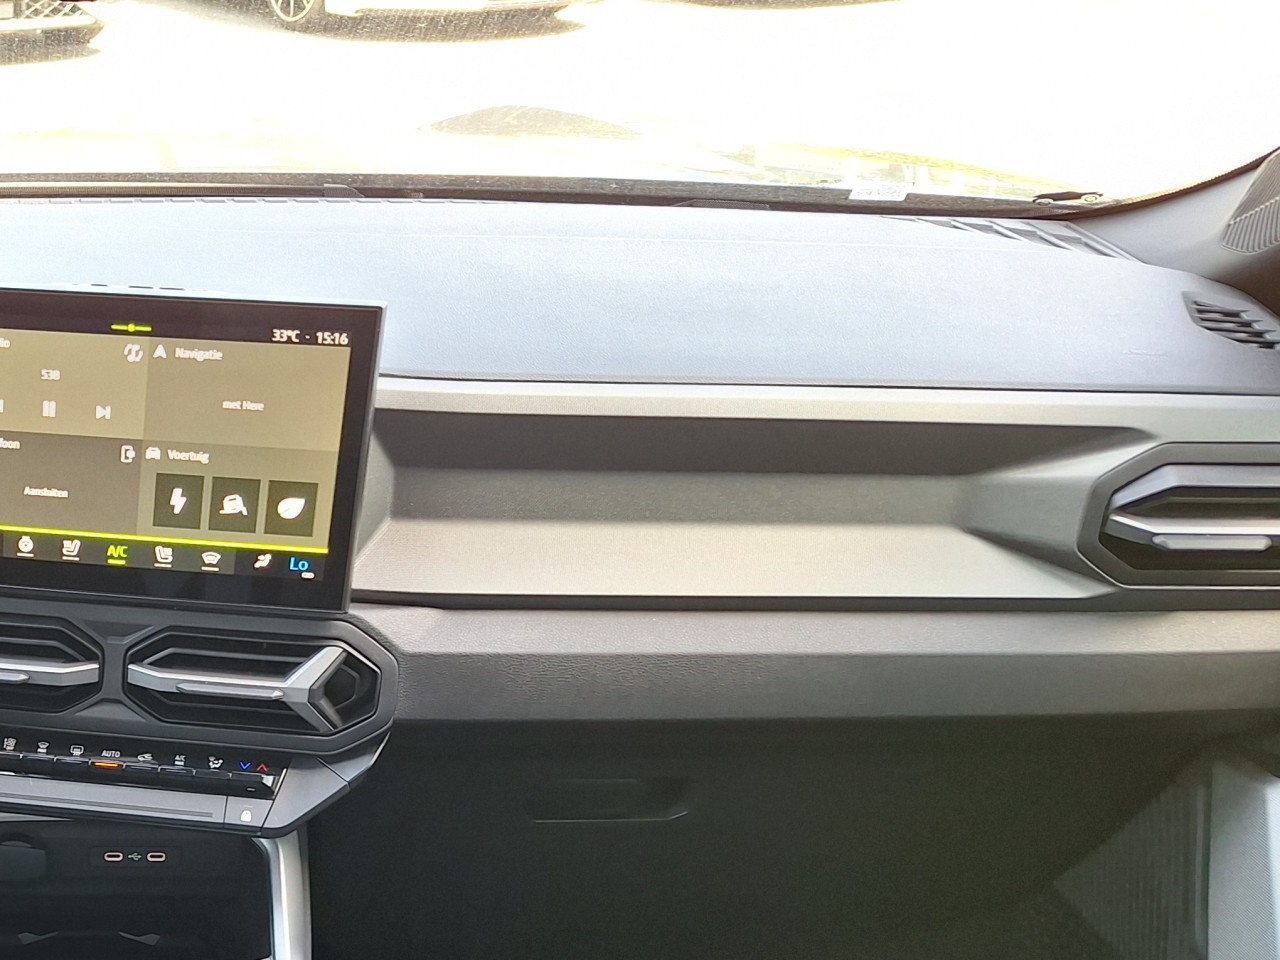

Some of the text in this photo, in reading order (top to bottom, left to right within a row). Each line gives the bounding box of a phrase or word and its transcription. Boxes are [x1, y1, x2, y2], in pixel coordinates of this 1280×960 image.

[316, 331, 349, 346] 15:16
[175, 347, 223, 362] Navigatie
[222, 400, 241, 410] met
[168, 448, 210, 464] Voertuig
[107, 545, 128, 557] A/C
[289, 557, 308, 571] Lo
[101, 750, 120, 758] AUTO
